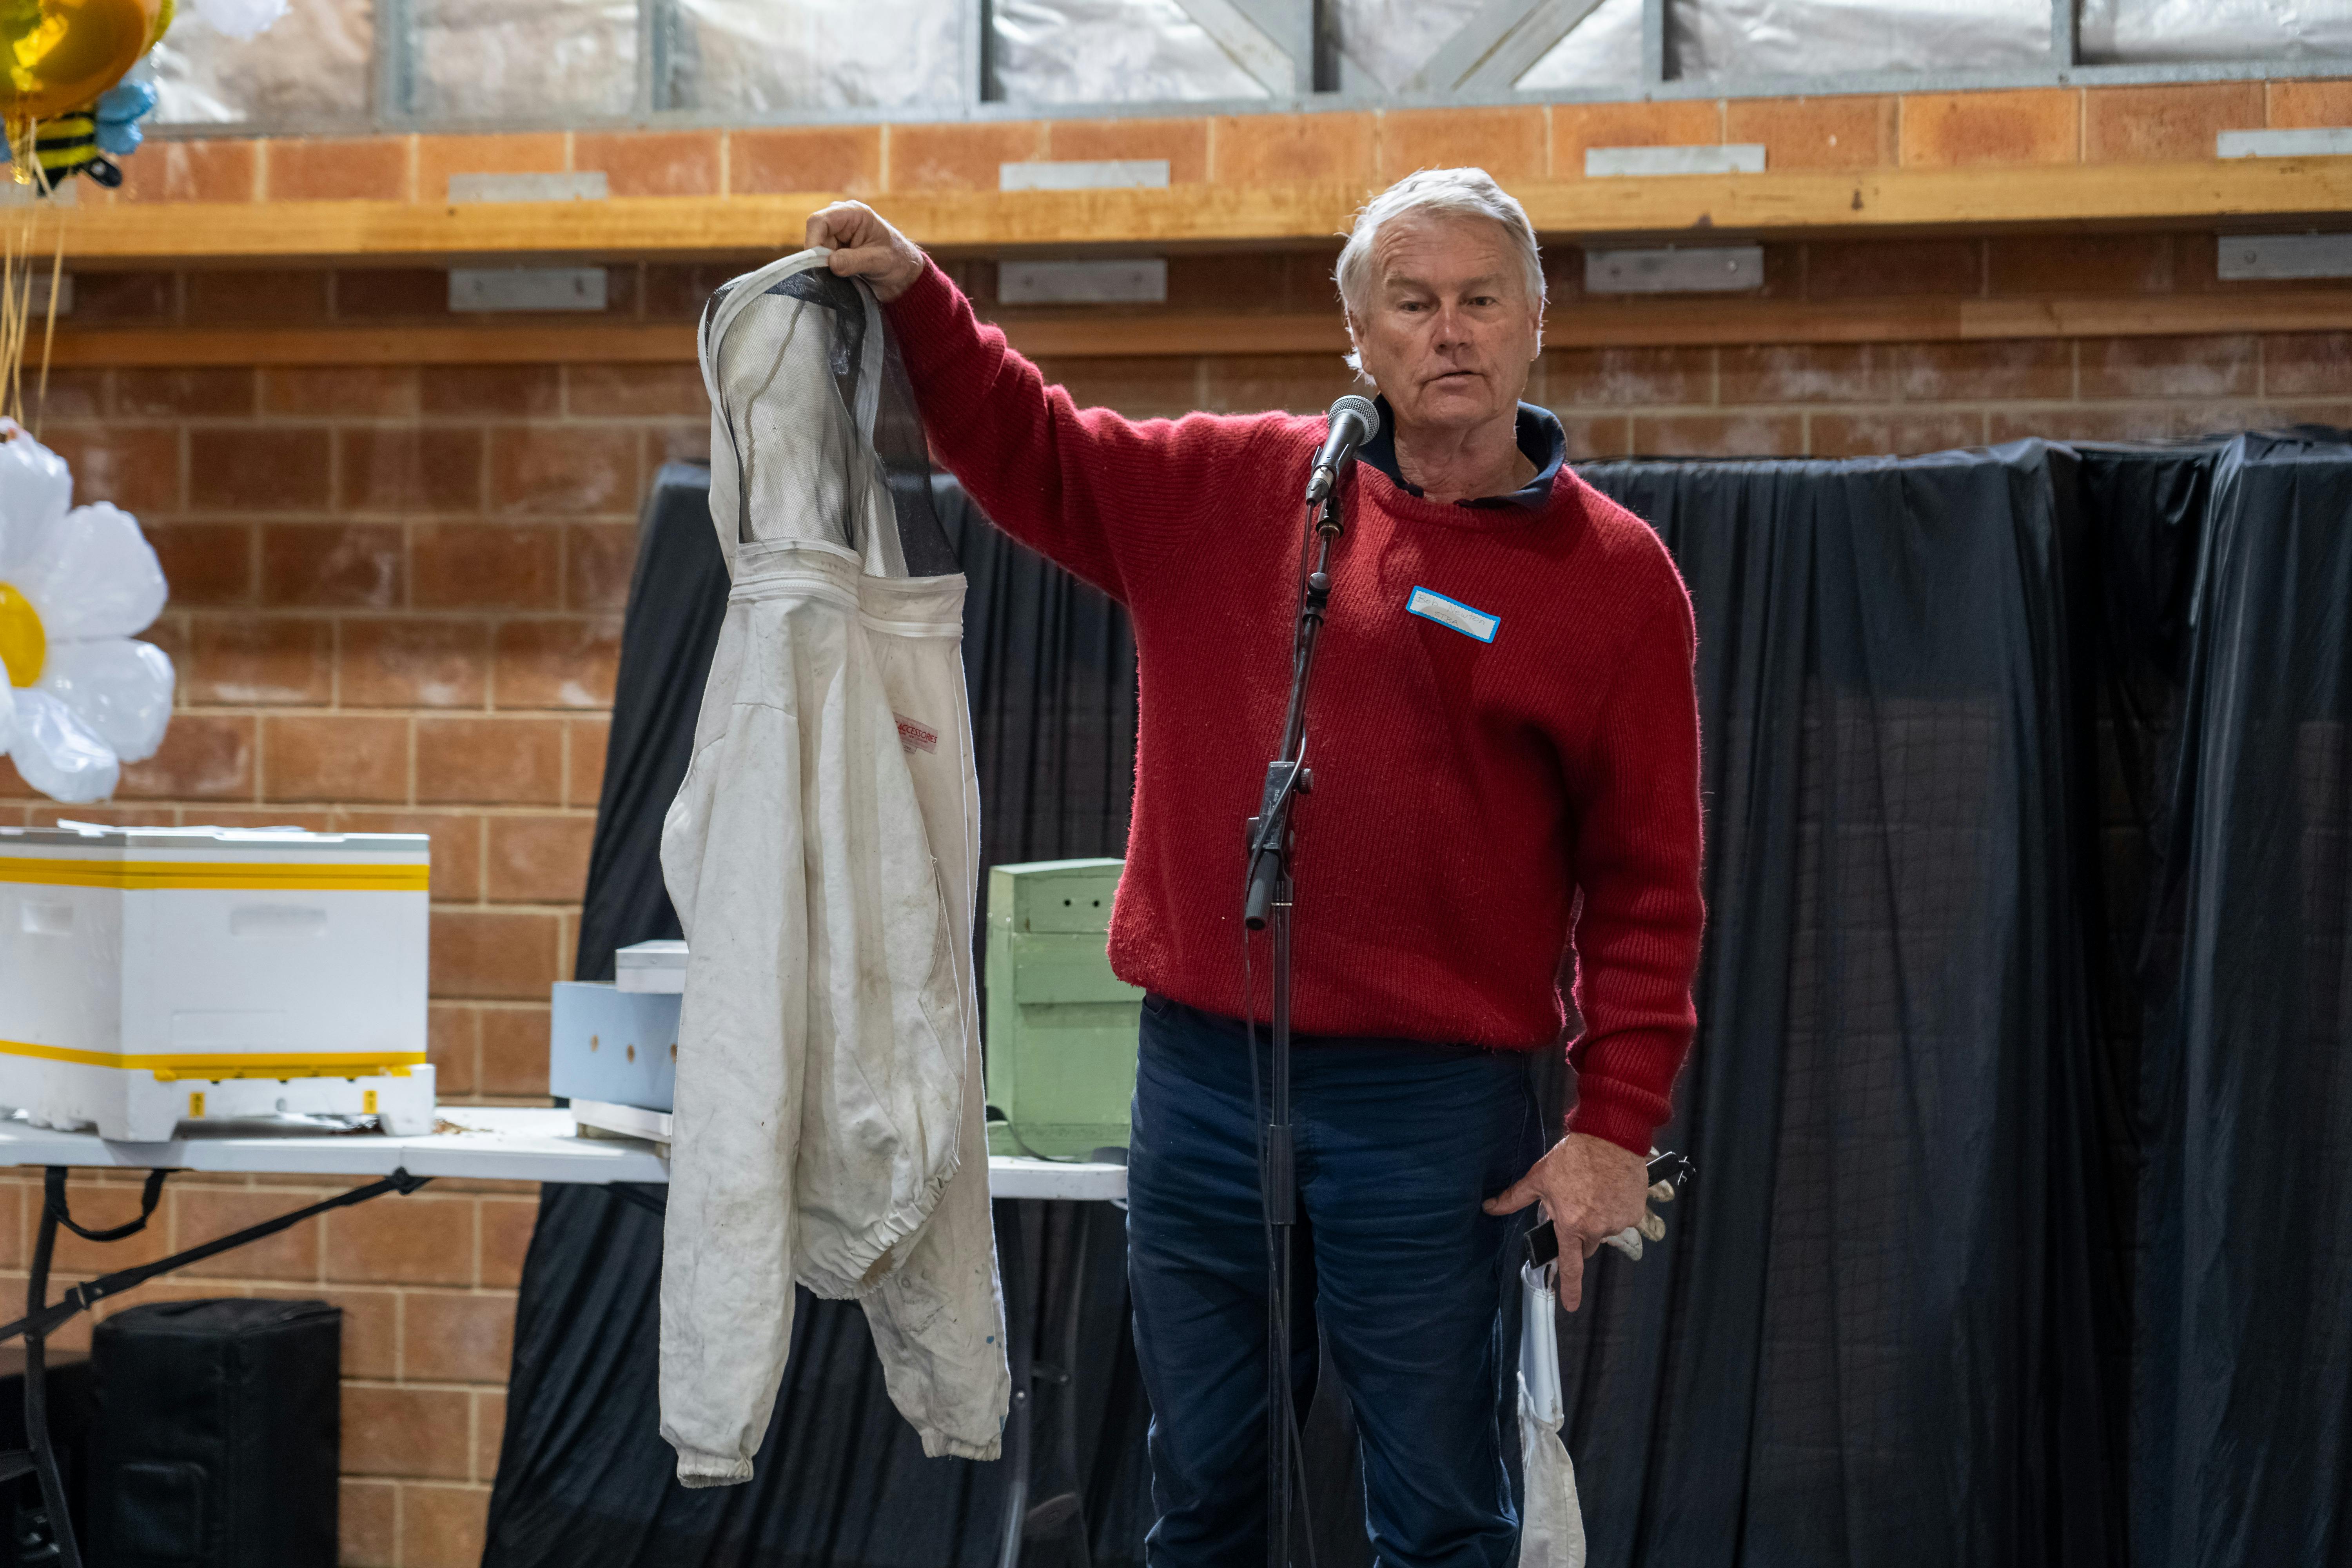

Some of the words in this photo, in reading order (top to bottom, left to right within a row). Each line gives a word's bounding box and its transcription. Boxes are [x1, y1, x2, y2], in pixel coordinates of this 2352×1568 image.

[1416, 594, 1438, 607] Bob
[1447, 604, 1485, 625] Newton
[1434, 611, 1459, 626] STBA
[898, 723, 938, 744] ACCESSORIES
